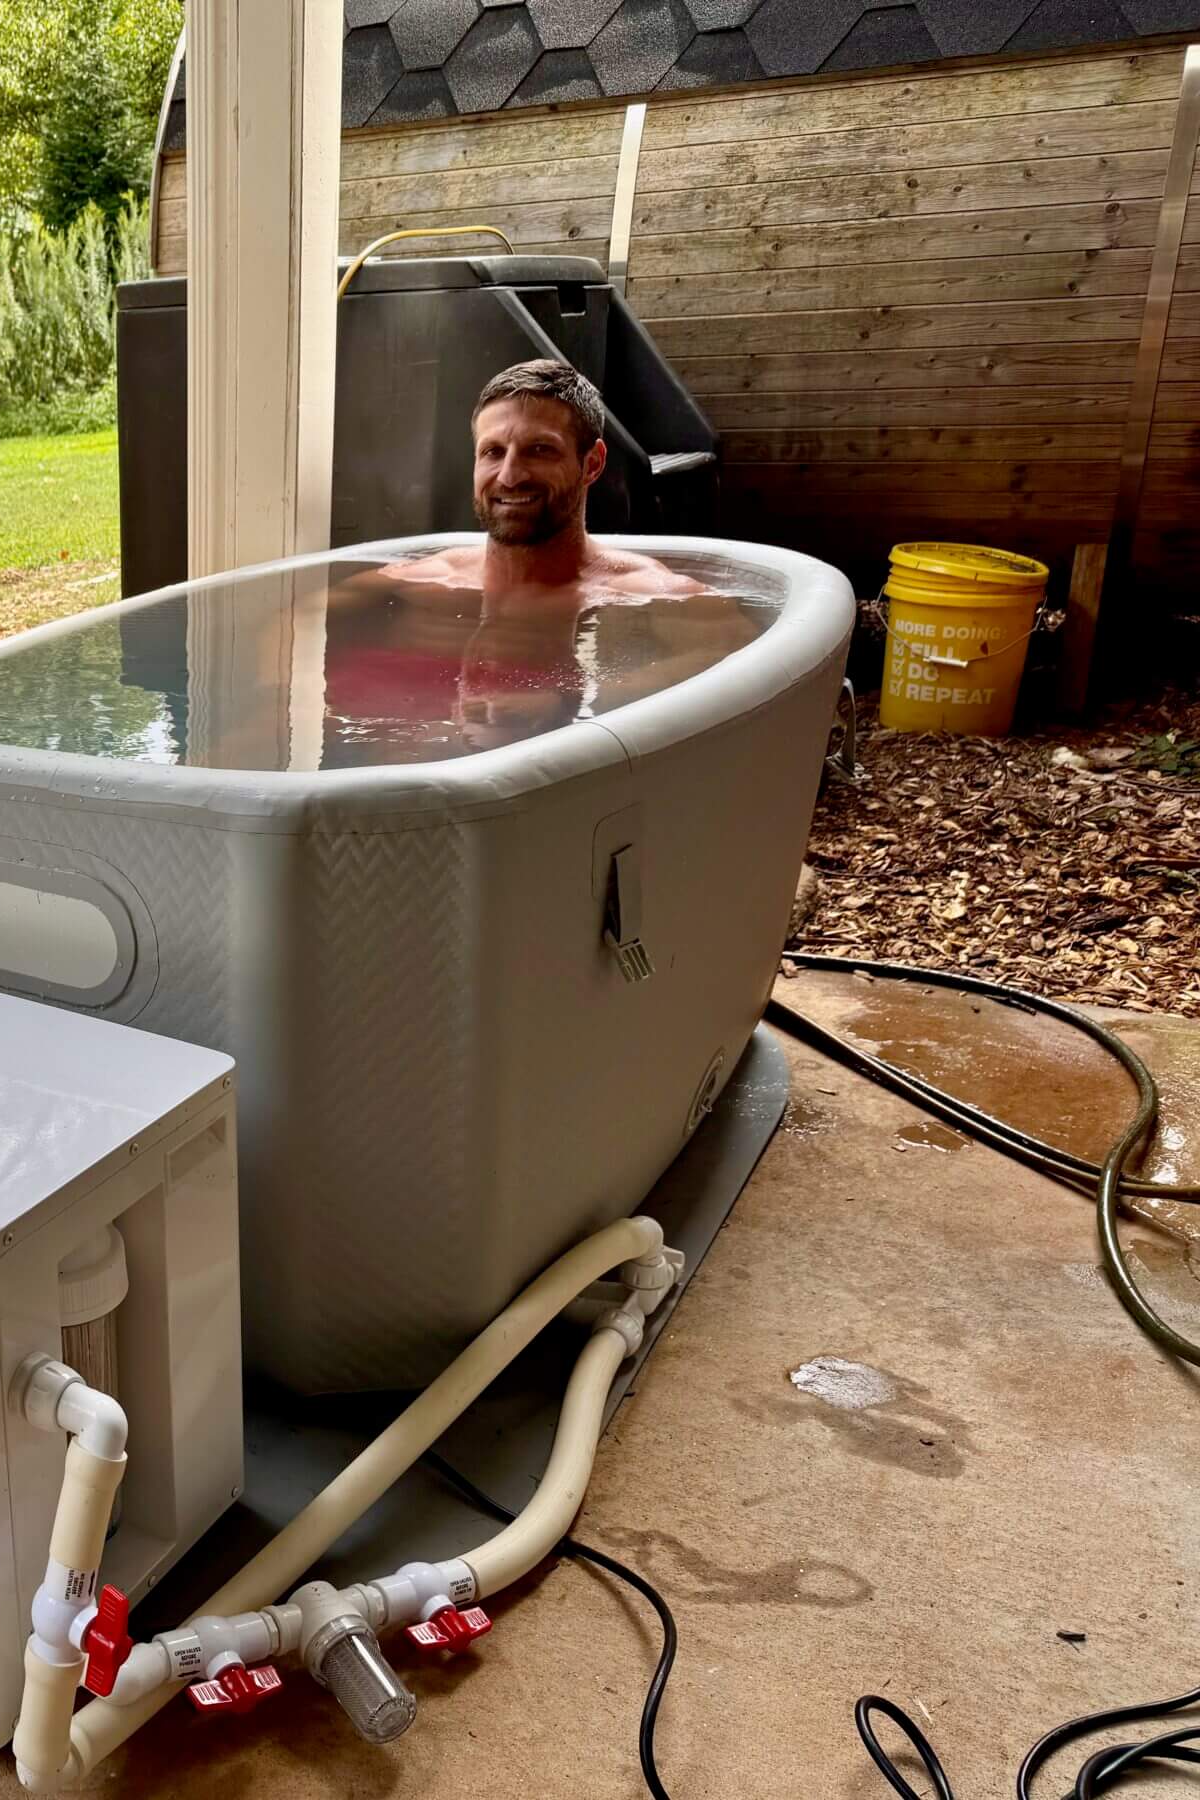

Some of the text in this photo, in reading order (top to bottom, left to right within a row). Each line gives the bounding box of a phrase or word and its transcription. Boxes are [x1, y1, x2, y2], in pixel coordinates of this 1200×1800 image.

[895, 619, 936, 637] MORE
[908, 663, 940, 682] DO
[905, 683, 996, 704] REPEAT
